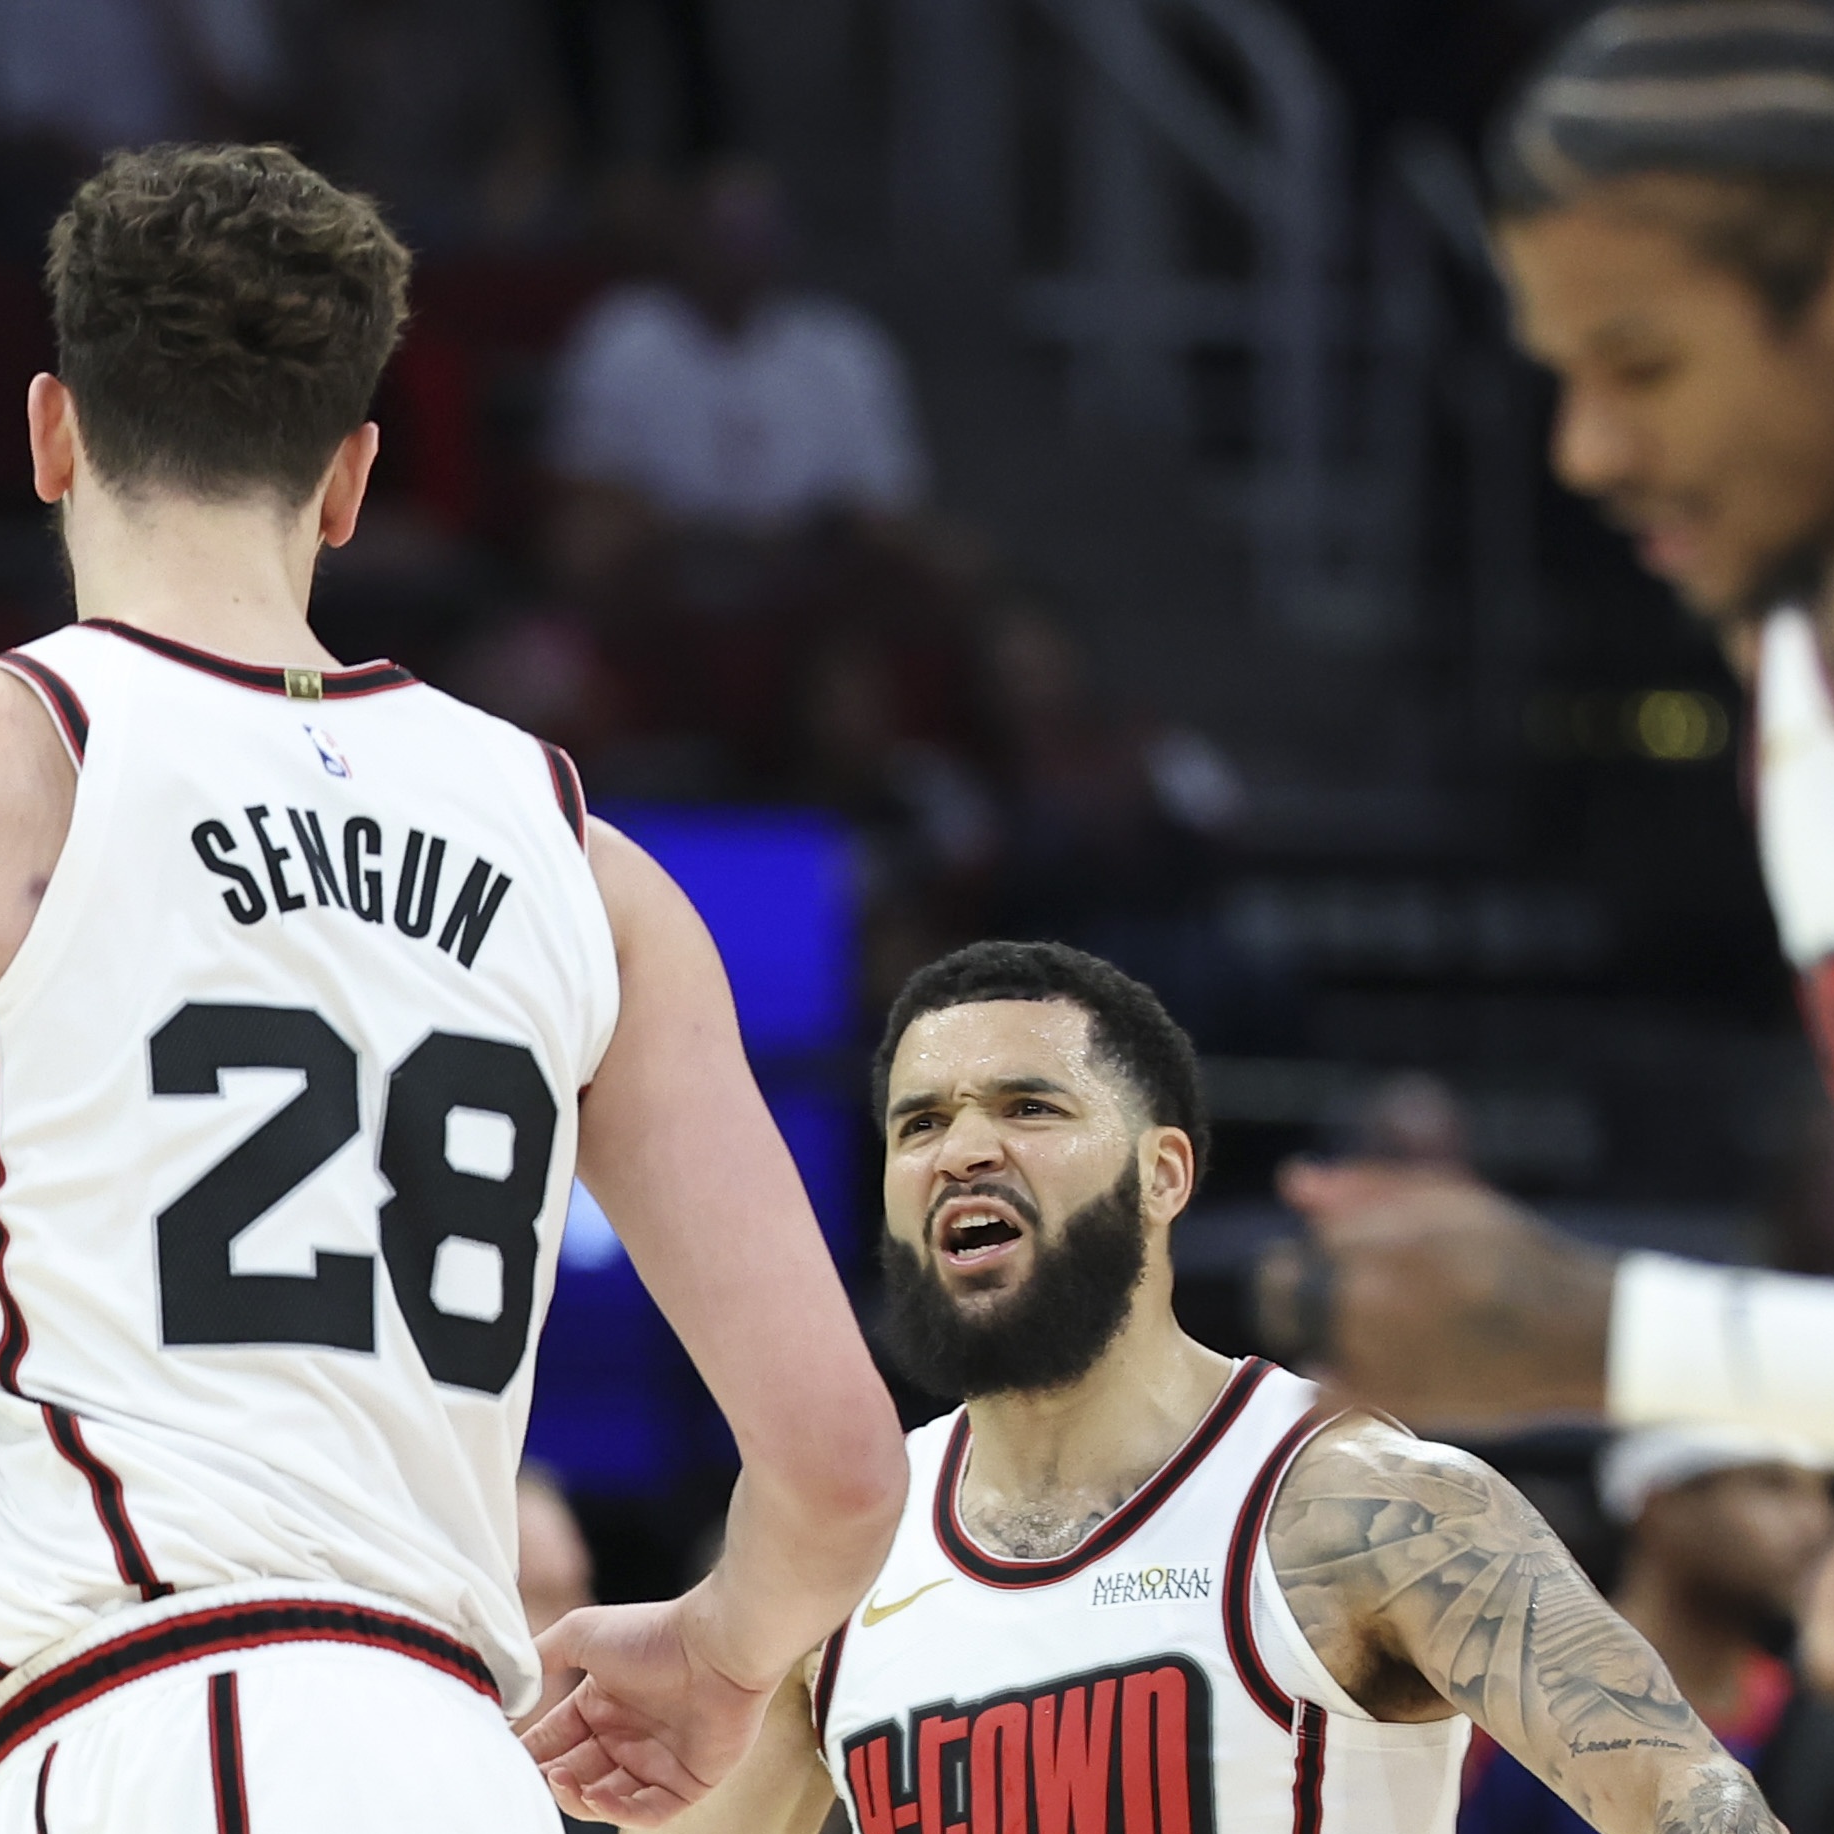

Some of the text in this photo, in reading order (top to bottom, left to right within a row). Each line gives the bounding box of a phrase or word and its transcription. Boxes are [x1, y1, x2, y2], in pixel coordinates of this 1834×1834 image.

[190, 804, 513, 970] SENGUN
[148, 1000, 558, 1397] 28
[1092, 1583, 1210, 1606] HERMANN
[1095, 1567, 1213, 1591] MEMORIAL
